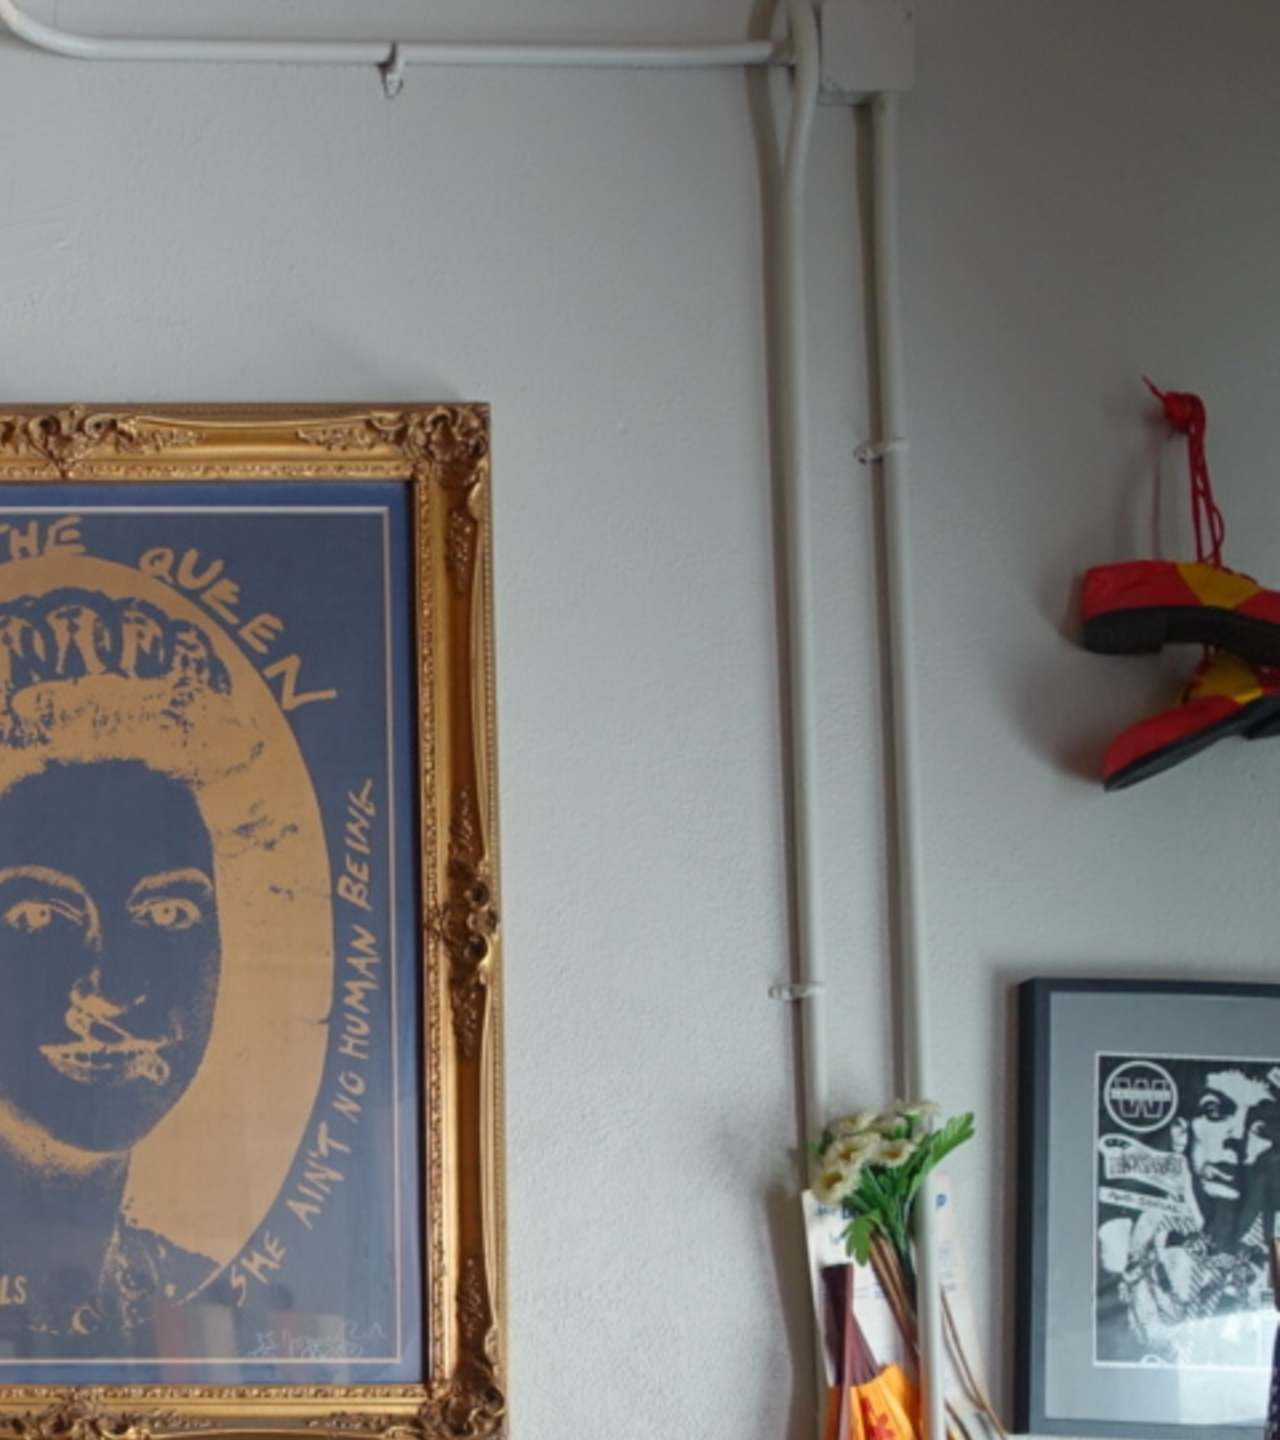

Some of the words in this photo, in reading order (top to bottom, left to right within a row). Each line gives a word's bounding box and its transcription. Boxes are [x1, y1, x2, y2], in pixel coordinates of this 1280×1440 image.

[139, 547, 337, 712] QUEEN
[337, 778, 374, 912] BEING
[339, 925, 382, 1061] HUMAN
[334, 1069, 367, 1125] NO
[286, 1120, 352, 1231] AIN'T
[229, 1230, 288, 1308] SHE
